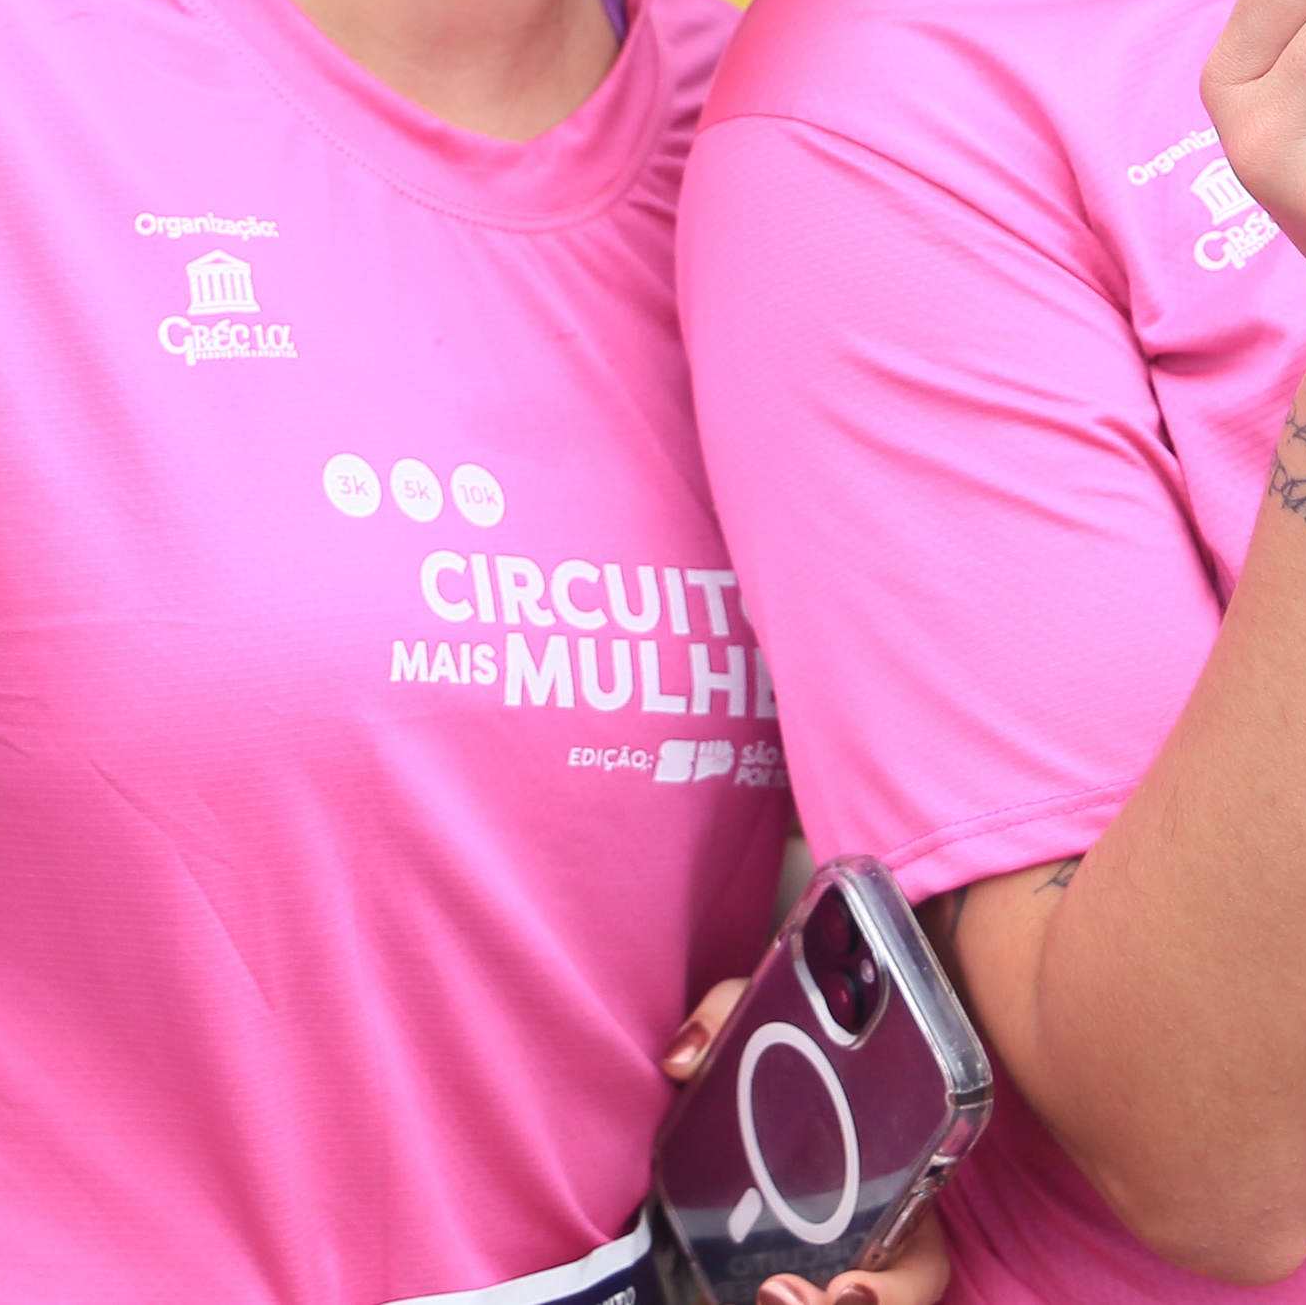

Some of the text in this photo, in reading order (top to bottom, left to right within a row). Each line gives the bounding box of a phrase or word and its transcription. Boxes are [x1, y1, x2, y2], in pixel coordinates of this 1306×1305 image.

[133, 210, 280, 241] Organização:
[336, 474, 371, 498] 3k
[458, 483, 500, 509] 10k
[389, 639, 498, 685] MAIS
[566, 744, 655, 772] EDIÇÃO:
